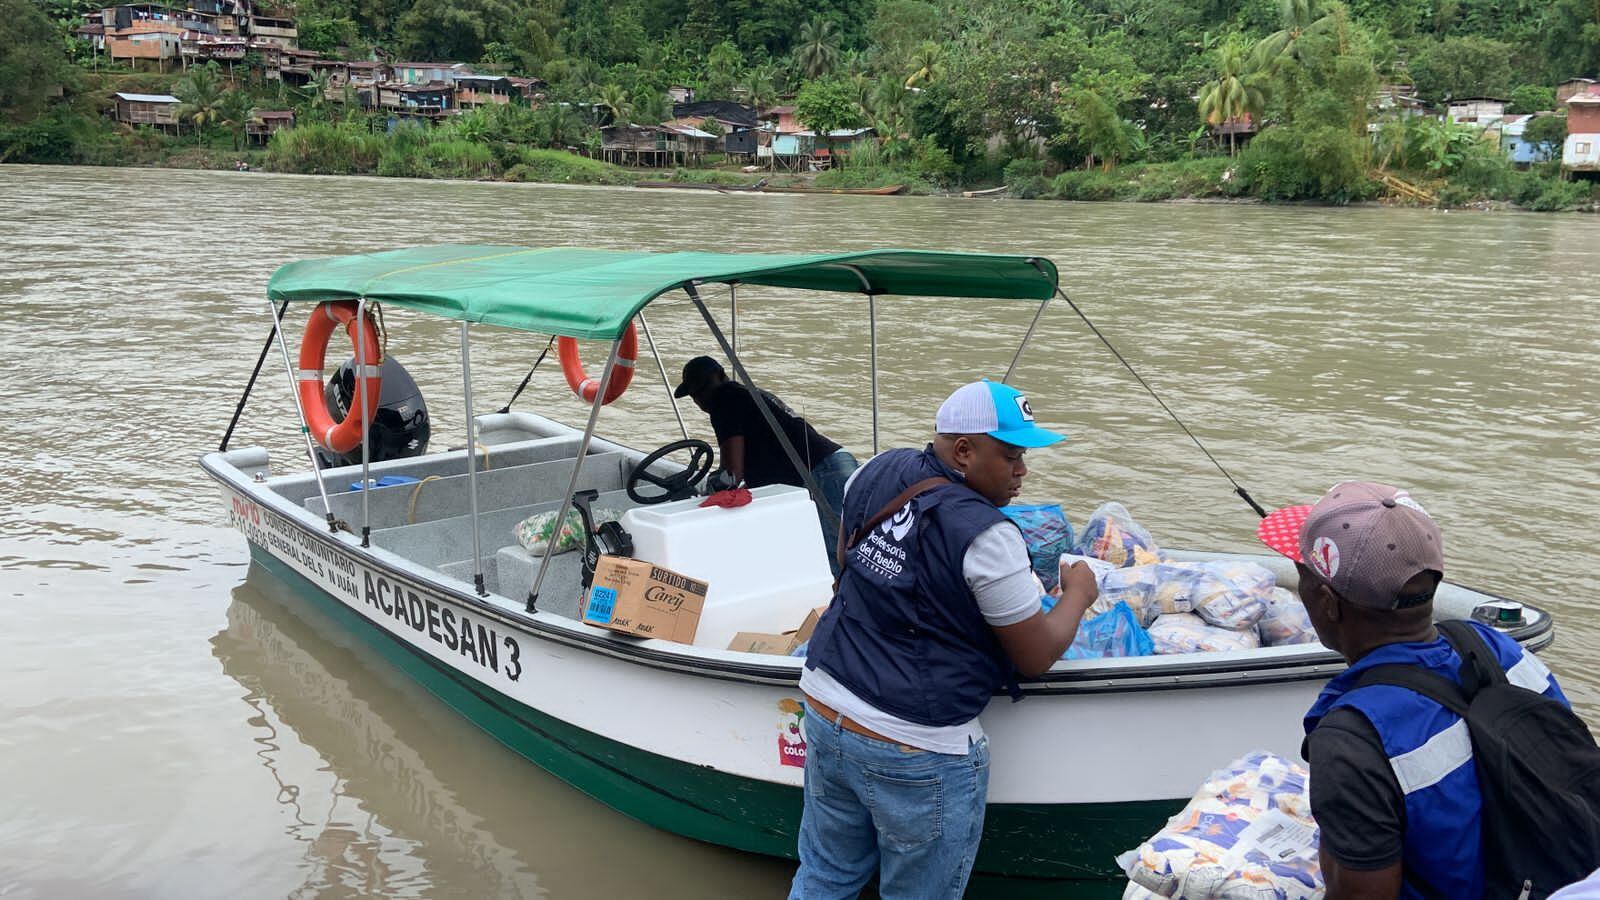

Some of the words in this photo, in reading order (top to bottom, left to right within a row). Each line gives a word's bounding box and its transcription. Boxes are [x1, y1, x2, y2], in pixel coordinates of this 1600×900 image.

[263, 511, 297, 542] CONSEJO
[297, 530, 355, 577] COMUNITARIO
[267, 531, 302, 563] GENERAL
[301, 551, 318, 574] DEL
[859, 542, 875, 557] del
[872, 550, 903, 574] Pueblo
[651, 568, 687, 589] SURTIDO
[363, 570, 499, 674] ACADESAN
[503, 636, 522, 683] 3
[783, 745, 807, 757] COLO
